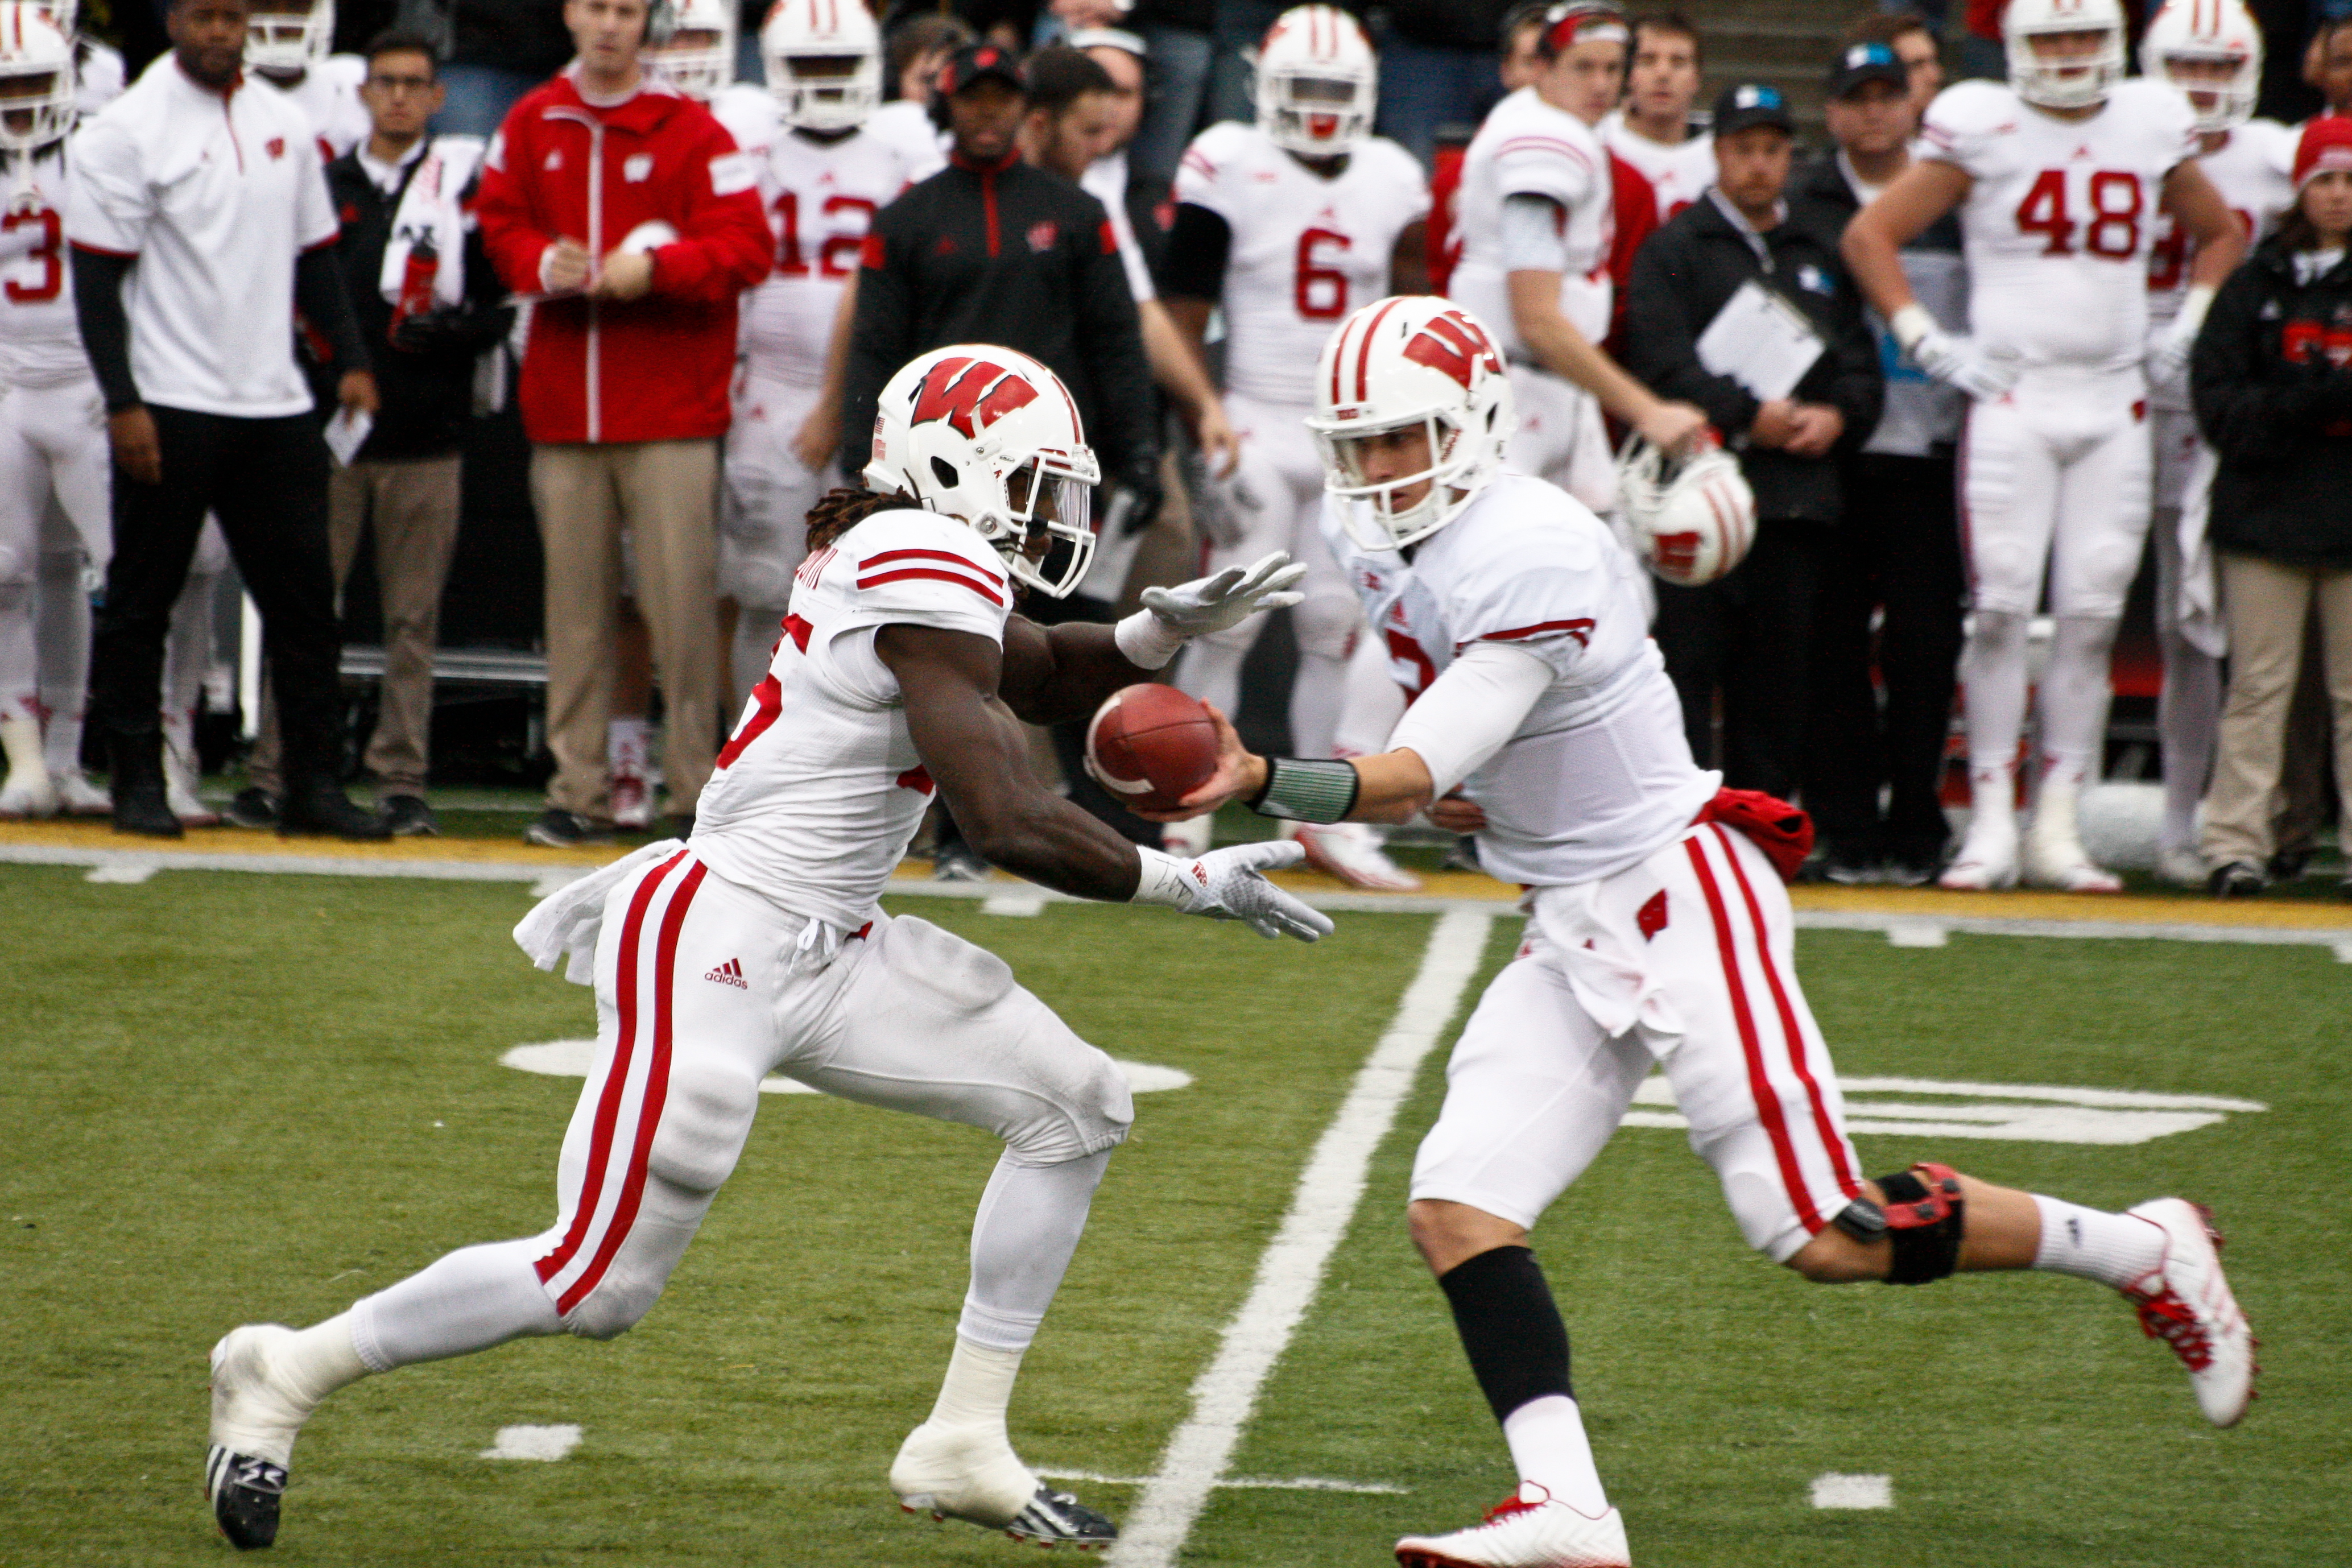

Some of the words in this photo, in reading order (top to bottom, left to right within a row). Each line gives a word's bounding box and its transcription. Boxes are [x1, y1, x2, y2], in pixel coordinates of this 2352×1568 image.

[1, 207, 62, 305] 3
[771, 192, 878, 278] 12
[2016, 169, 2143, 261] 48
[1295, 227, 1350, 320] 6
[910, 357, 1039, 440] W
[705, 973, 747, 990] adidas
